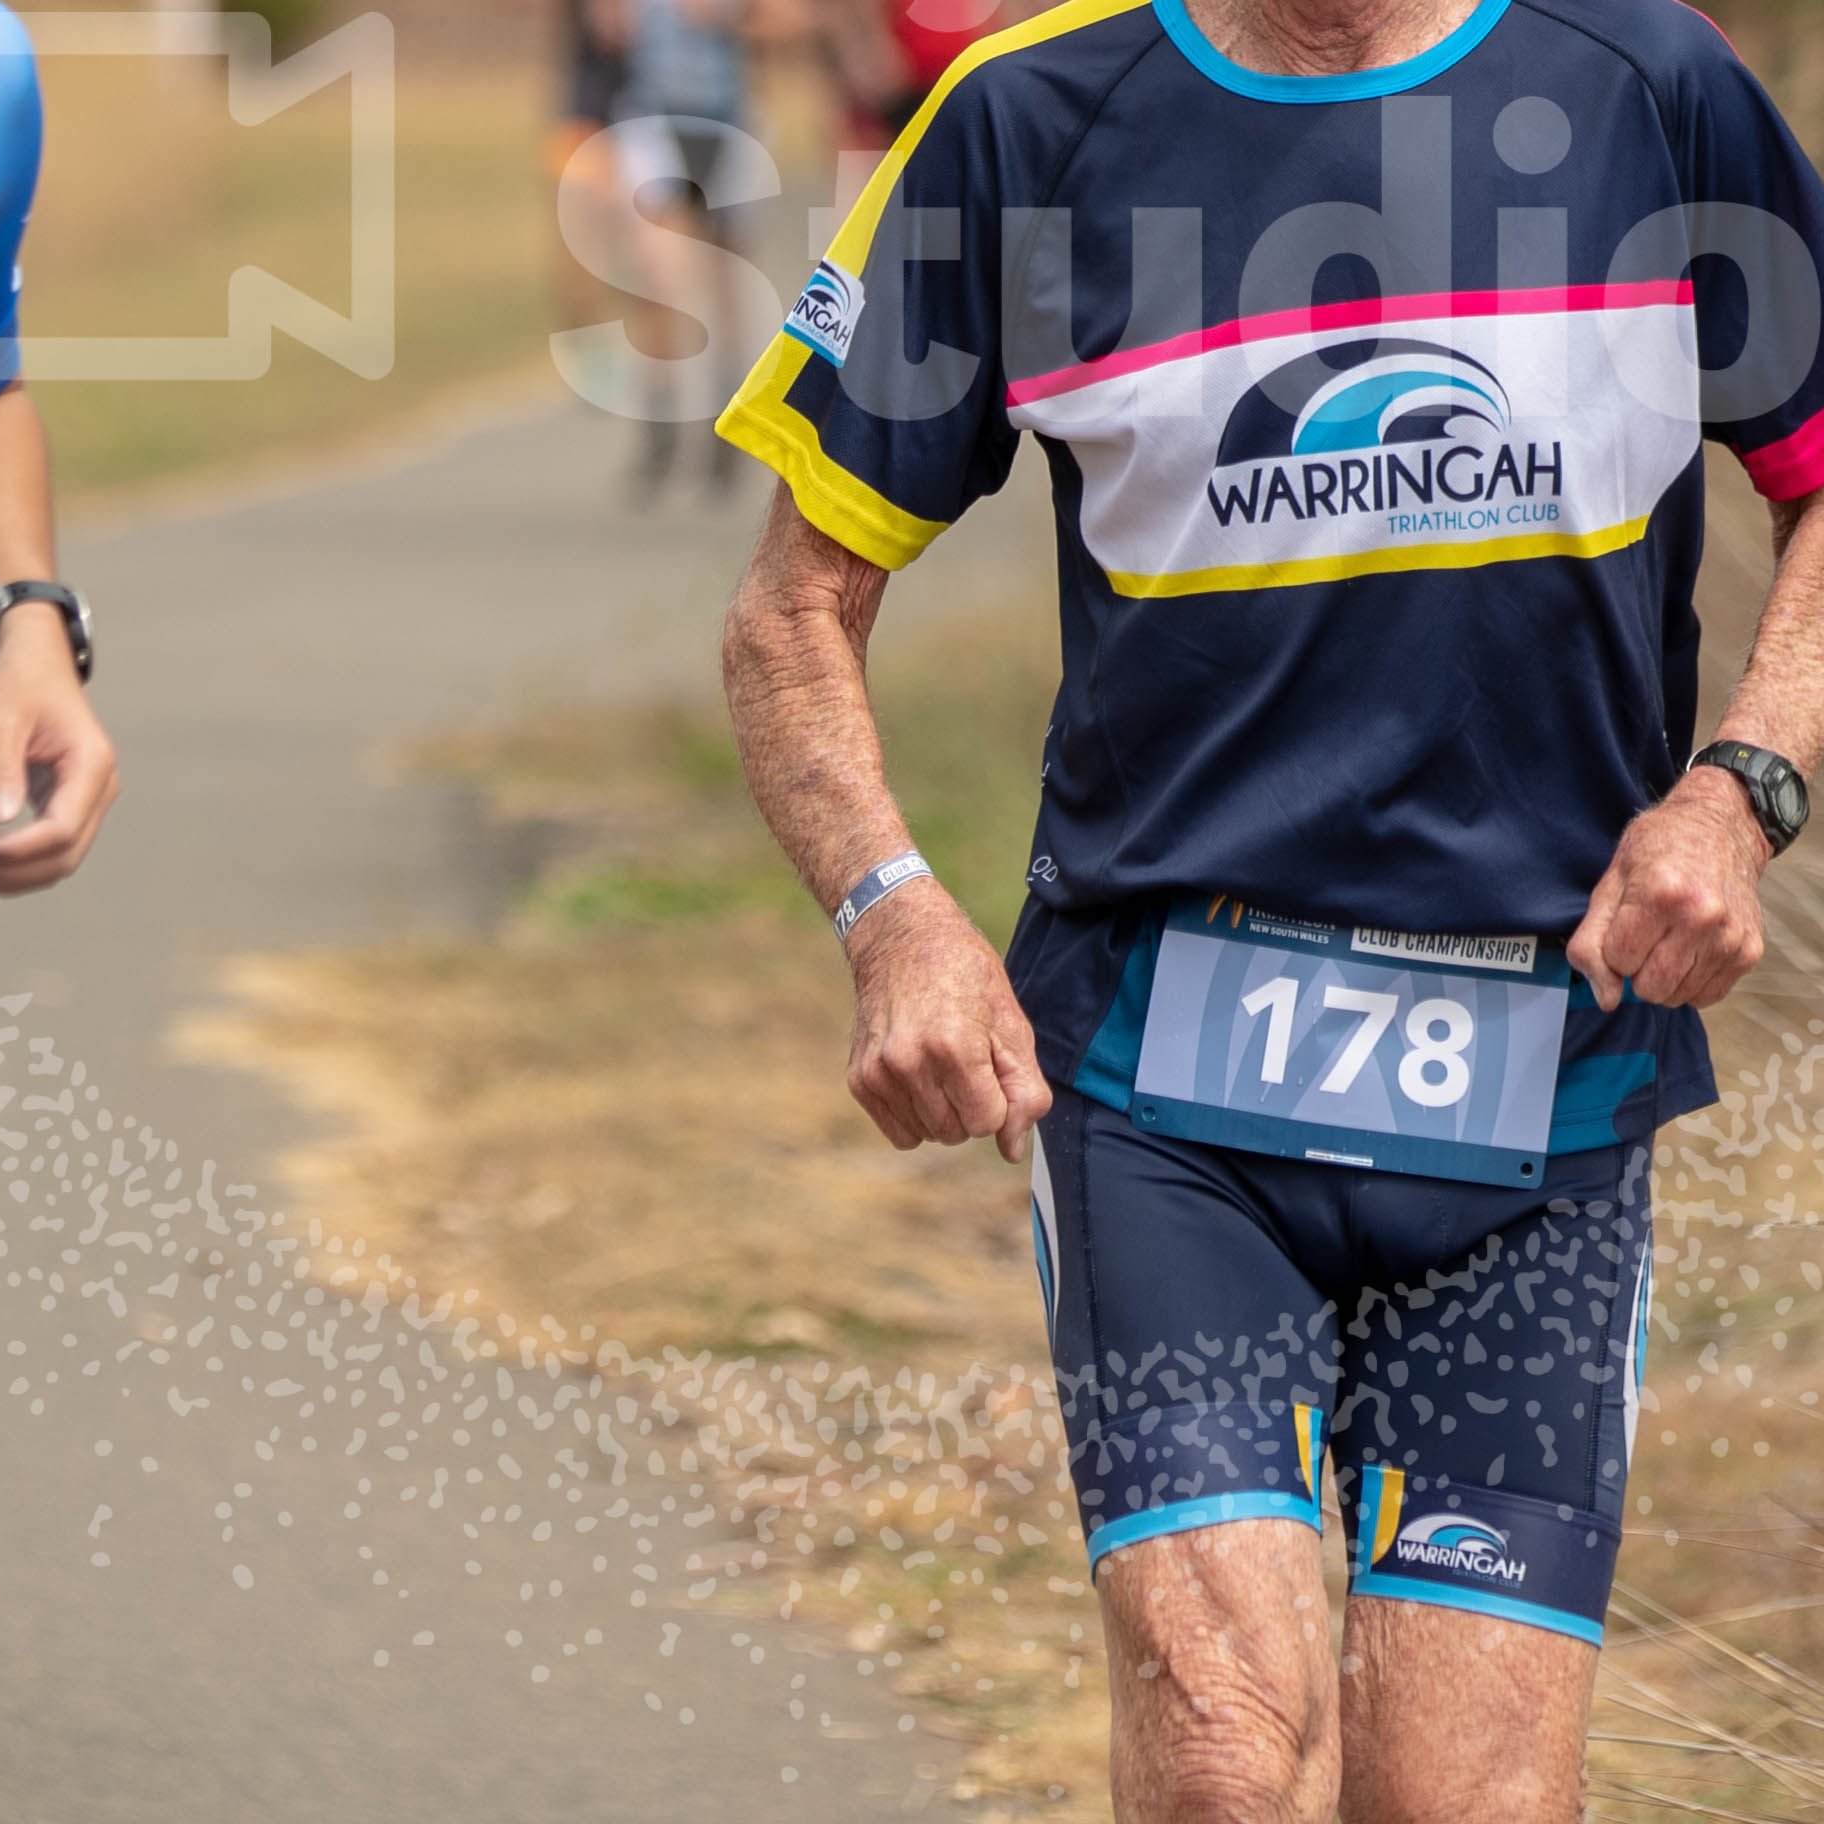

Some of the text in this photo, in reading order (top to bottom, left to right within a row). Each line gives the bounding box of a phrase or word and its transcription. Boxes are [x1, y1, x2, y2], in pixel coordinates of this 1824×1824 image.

[1207, 441, 1563, 527] WARRINGAH
[1387, 503, 1560, 535] TRIATHLON CLUB
[882, 862, 910, 883] CLUB
[1250, 923, 1330, 945] NEW SOUTH WALES
[1358, 927, 1531, 964] CLUB CHAMPIONSHIPS
[1241, 976, 1475, 1108] 178
[1397, 1539, 1526, 1582] WARRINGAH
